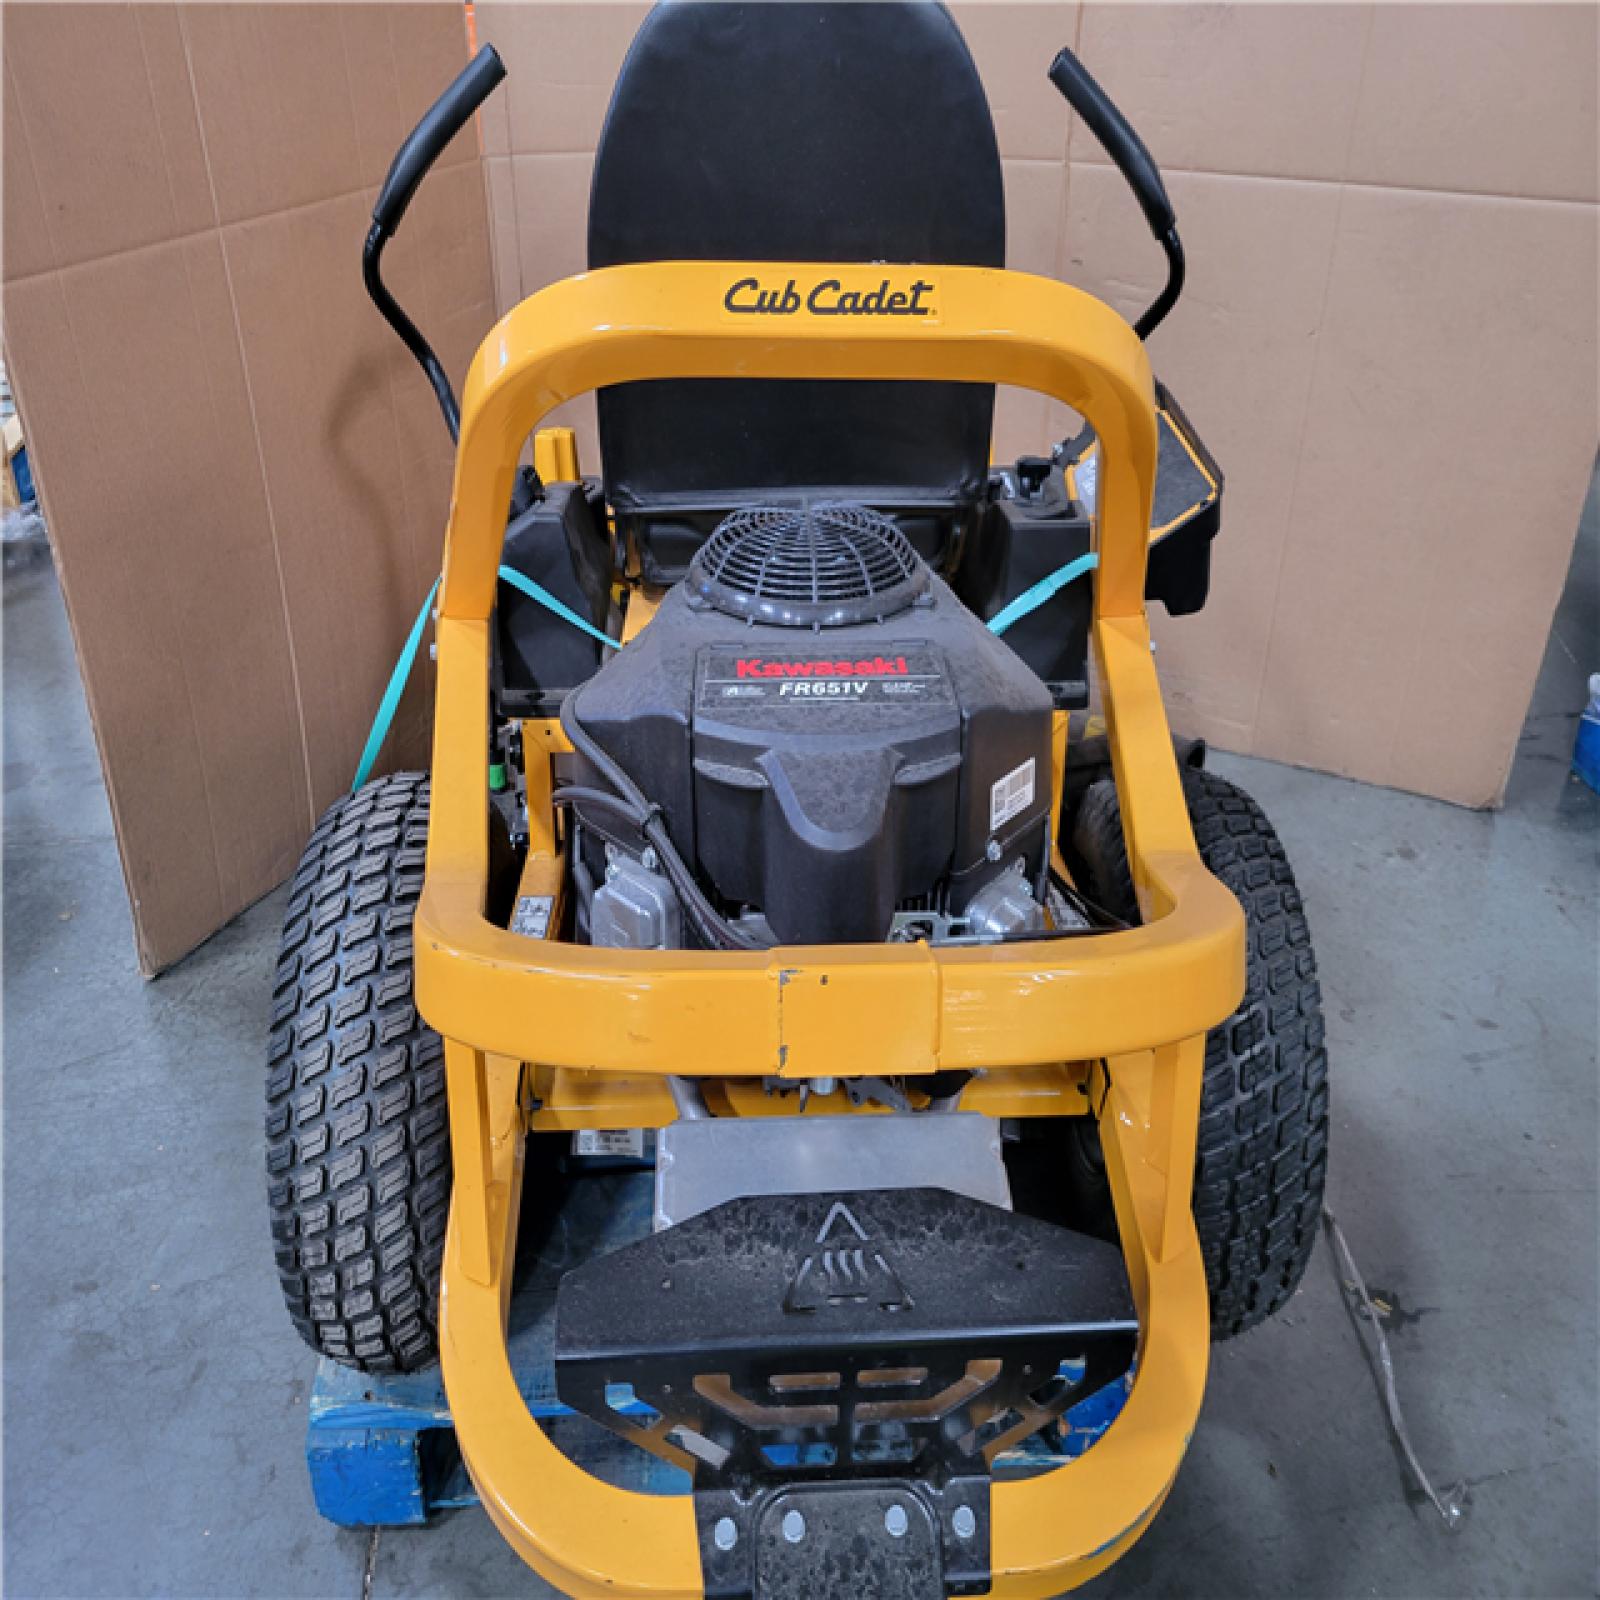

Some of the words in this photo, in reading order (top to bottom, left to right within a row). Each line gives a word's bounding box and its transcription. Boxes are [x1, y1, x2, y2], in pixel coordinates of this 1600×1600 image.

[724, 278, 801, 313] Cub
[807, 280, 934, 315] Cadet
[736, 656, 909, 678] Kawasaki
[779, 681, 869, 696] FR651V
